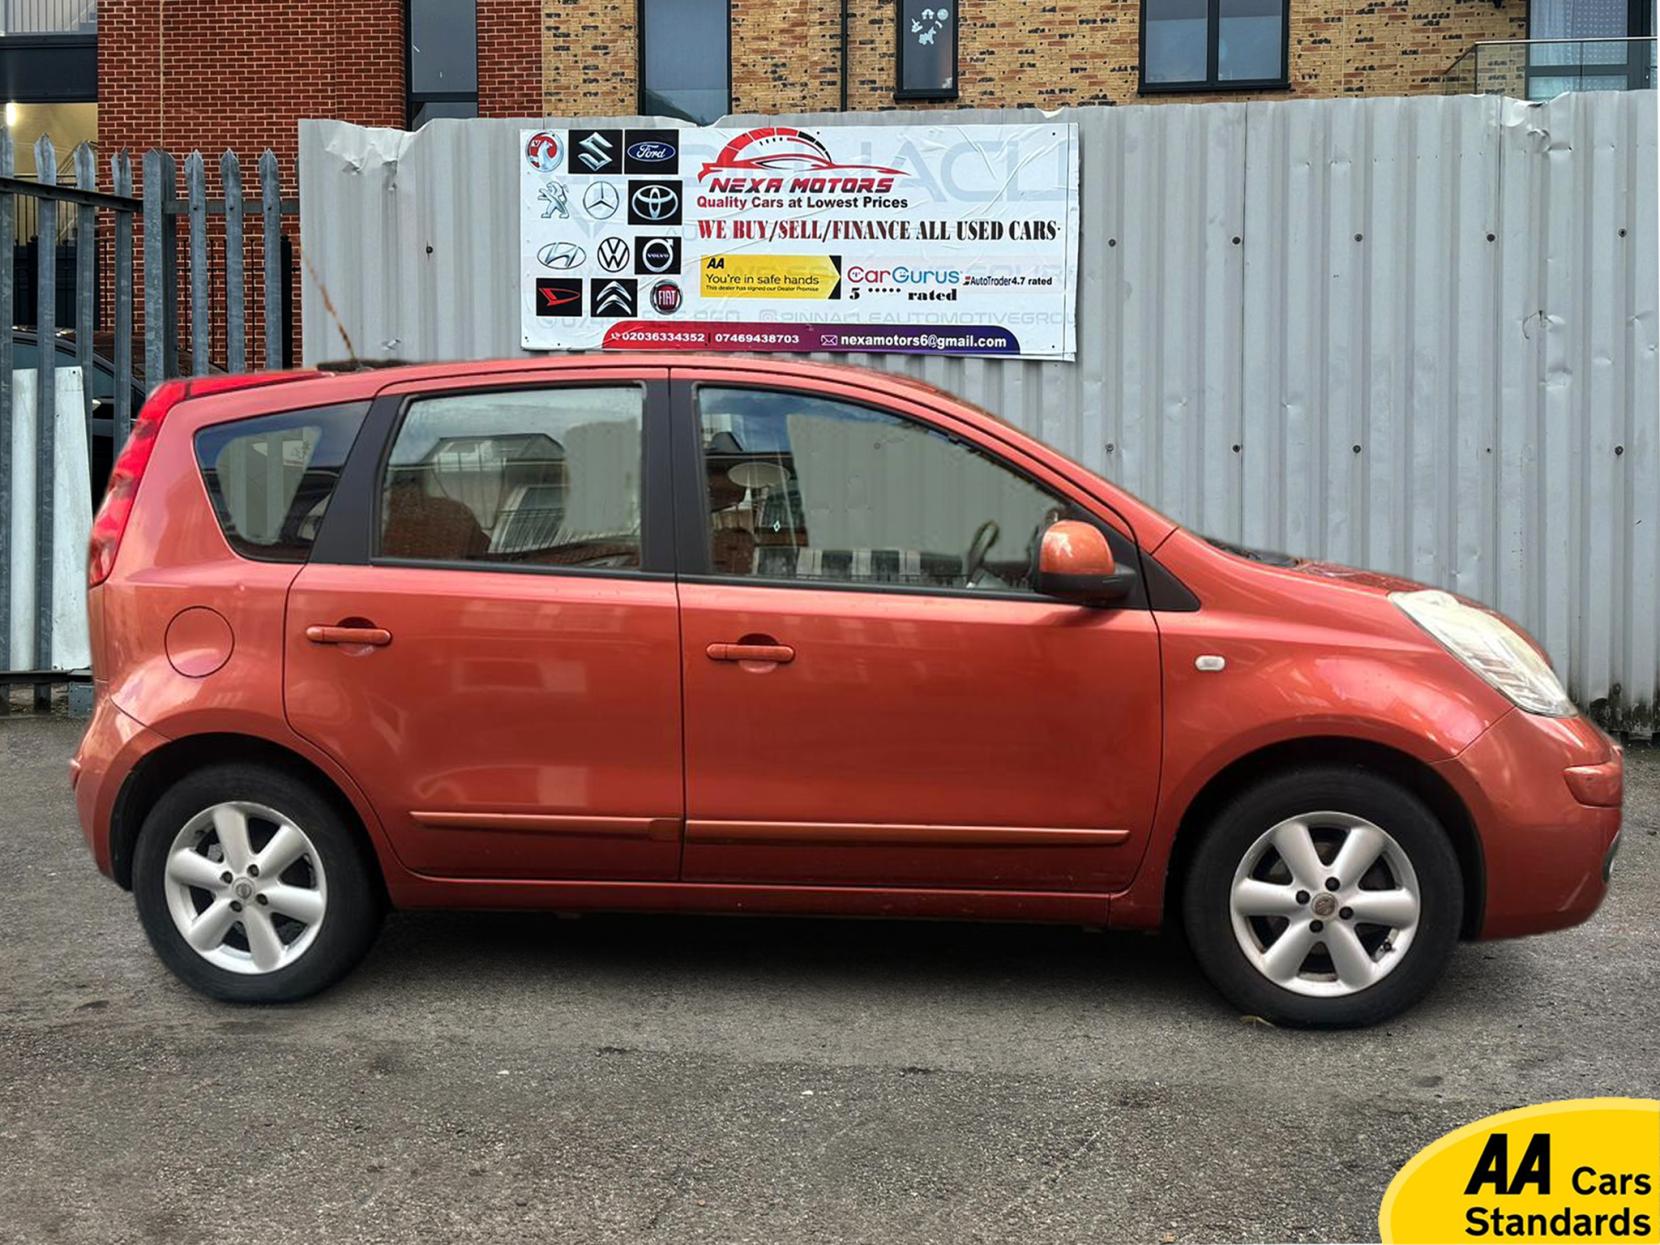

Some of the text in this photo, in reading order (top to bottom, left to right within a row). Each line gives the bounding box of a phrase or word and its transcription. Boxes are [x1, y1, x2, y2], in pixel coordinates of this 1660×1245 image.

[636, 144, 666, 159] Ford
[709, 178, 894, 193] NEXA MOTORS
[697, 196, 908, 210] Quality Cars at Lowest Prices
[698, 220, 727, 240] WE
[733, 220, 910, 242] BUY/SELL/FINANCE
[916, 221, 950, 240] ALL
[956, 221, 1003, 241] USED
[707, 257, 725, 269] AA
[706, 274, 819, 285] You're in safe hands
[847, 266, 959, 284] CarGurus
[1028, 277, 1053, 285] rated
[658, 290, 676, 305] FIAT
[849, 287, 957, 301] 5 rated
[622, 332, 1007, 348] 02036334352 07469438703 nexamotors6@gmail.com
